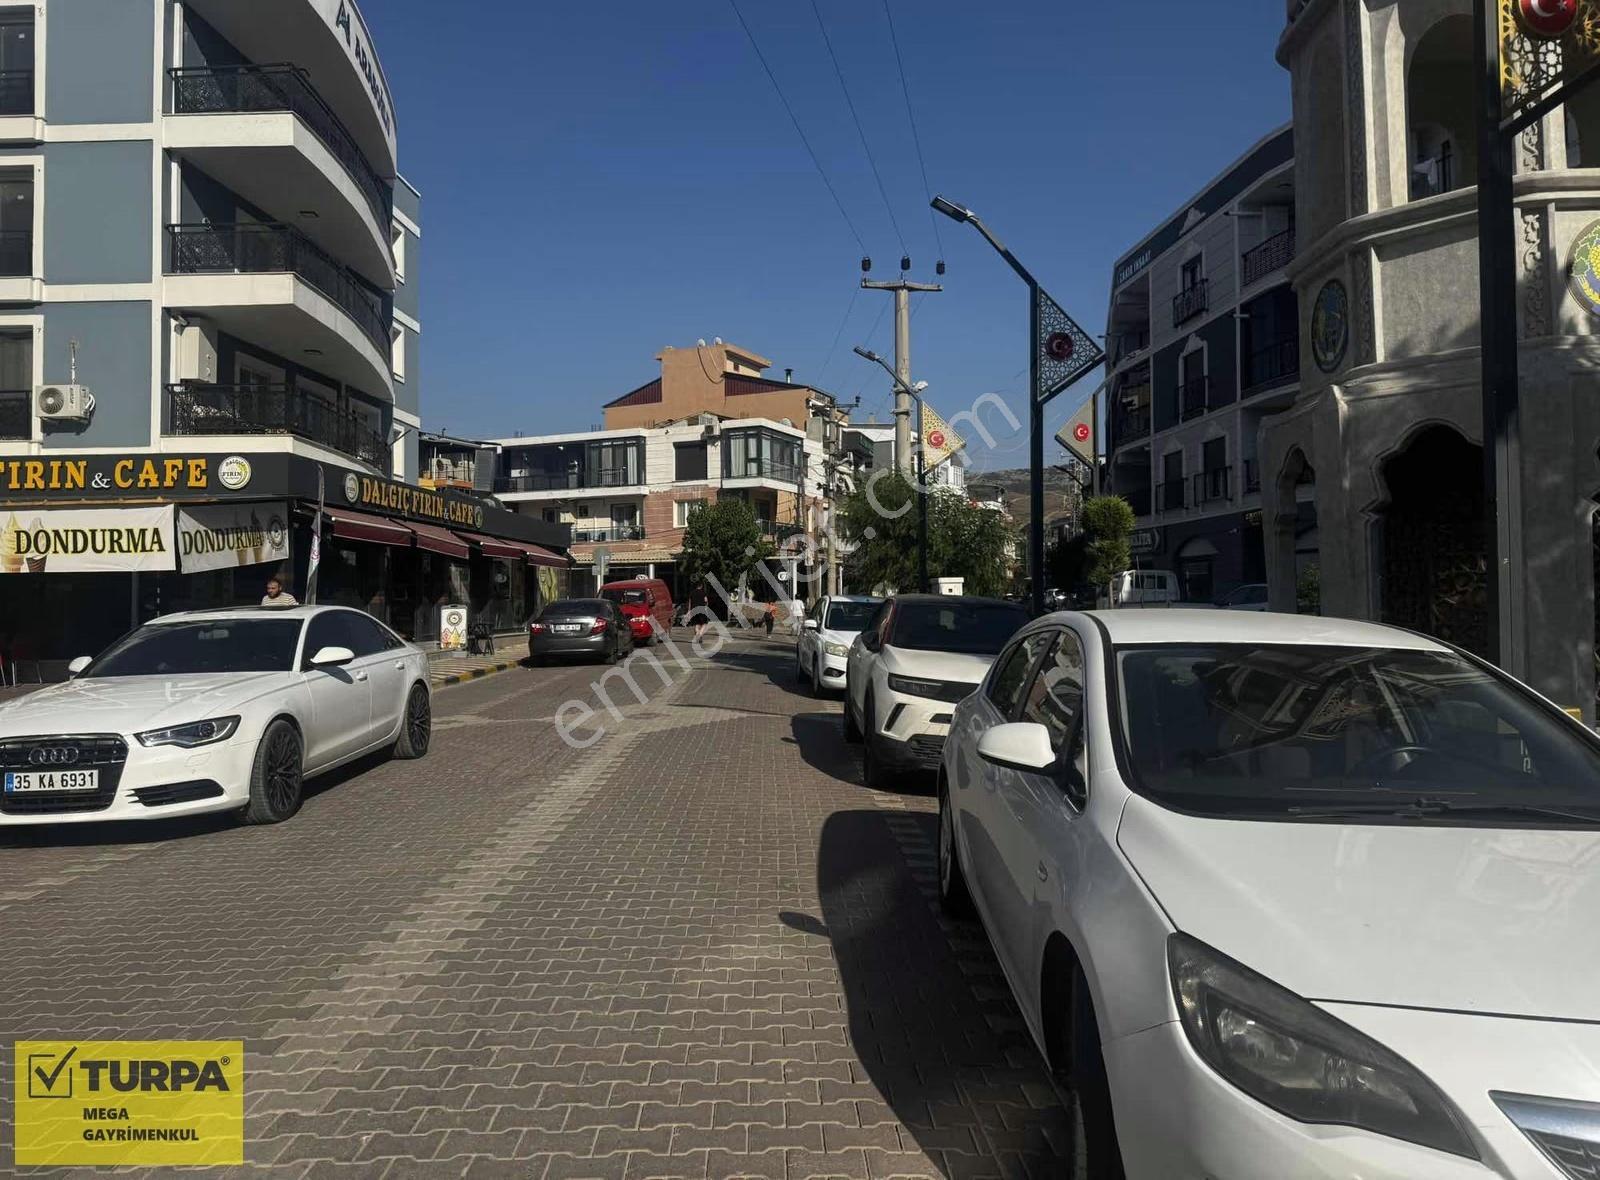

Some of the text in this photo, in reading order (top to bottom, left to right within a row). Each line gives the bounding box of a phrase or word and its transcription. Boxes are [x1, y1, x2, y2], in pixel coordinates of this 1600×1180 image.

[91, 472, 111, 489] &
[114, 458, 208, 489] CAFE
[412, 491, 443, 518] FIRIN
[449, 501, 473, 525] CAFE
[14, 527, 166, 555] DONDURMA
[181, 526, 263, 556] DONDURMA
[14, 775, 31, 789] 35
[38, 774, 55, 788] KA
[60, 772, 94, 787] 6931
